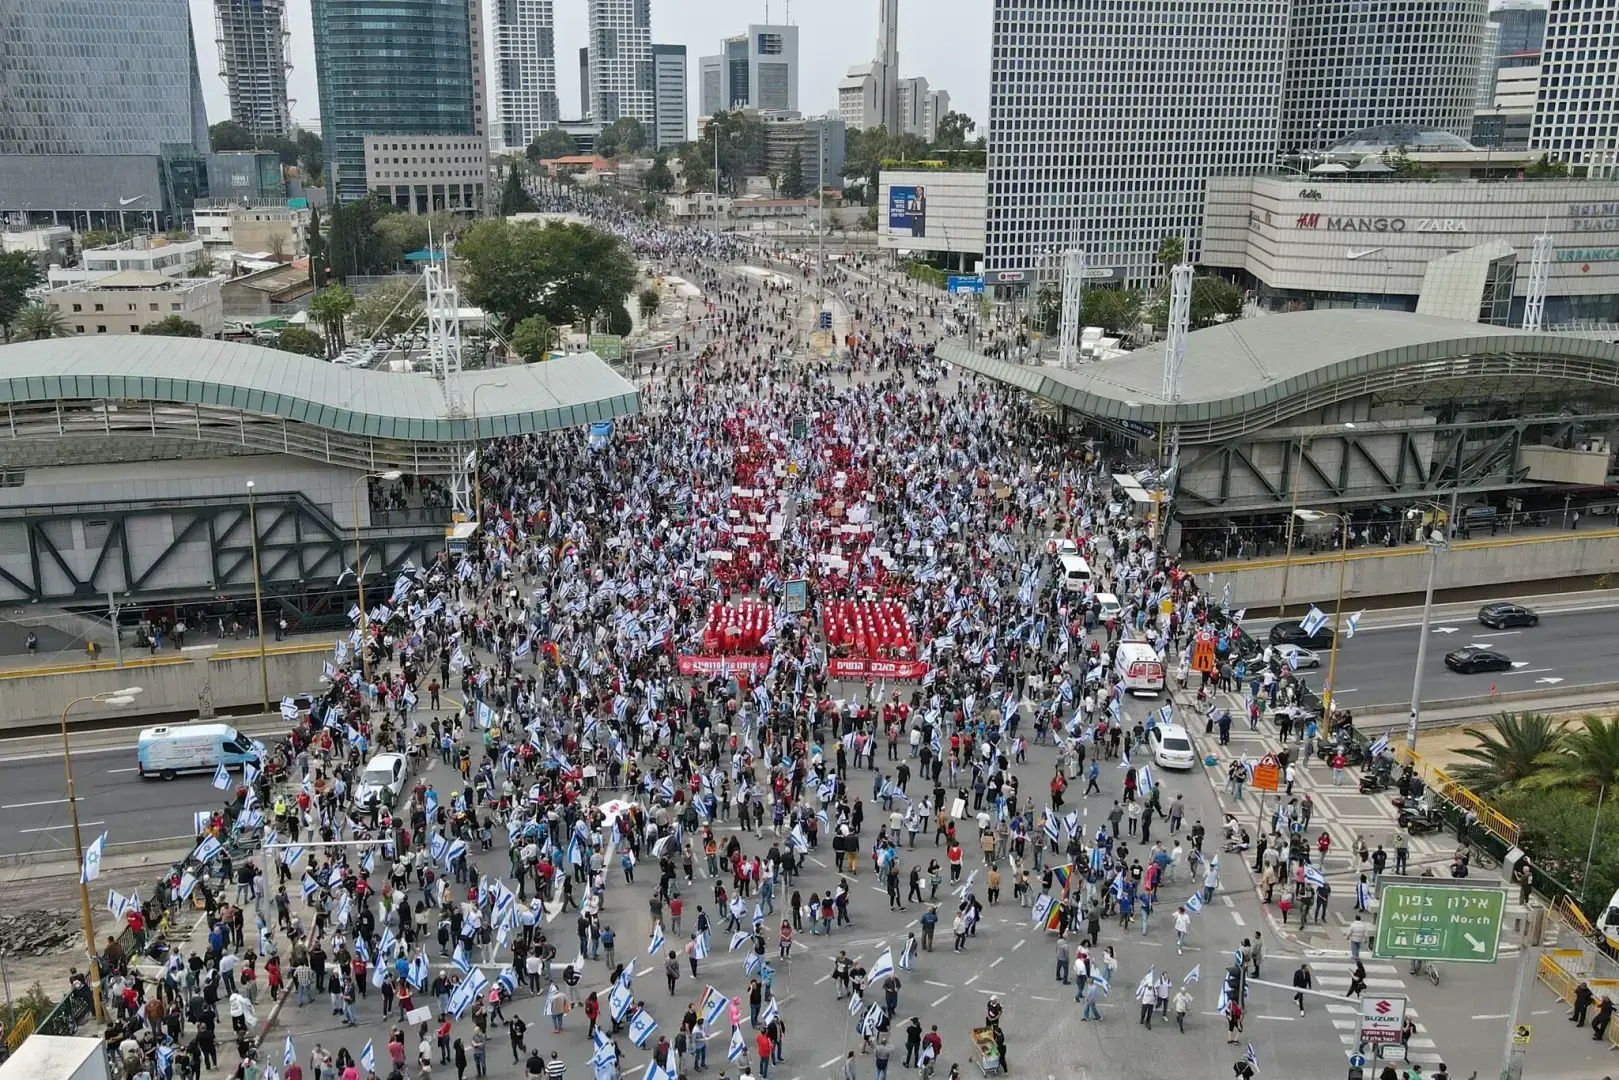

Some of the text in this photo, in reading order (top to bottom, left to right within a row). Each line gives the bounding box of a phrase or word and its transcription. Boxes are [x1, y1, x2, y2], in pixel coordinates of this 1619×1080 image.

[1326, 217, 1406, 232] MANGO
[1417, 218, 1468, 232] ZARA
[836, 661, 896, 672] מאבק הנשים
[1398, 894, 1489, 909] אילון צפון
[1391, 911, 1490, 925] Ayalon North
